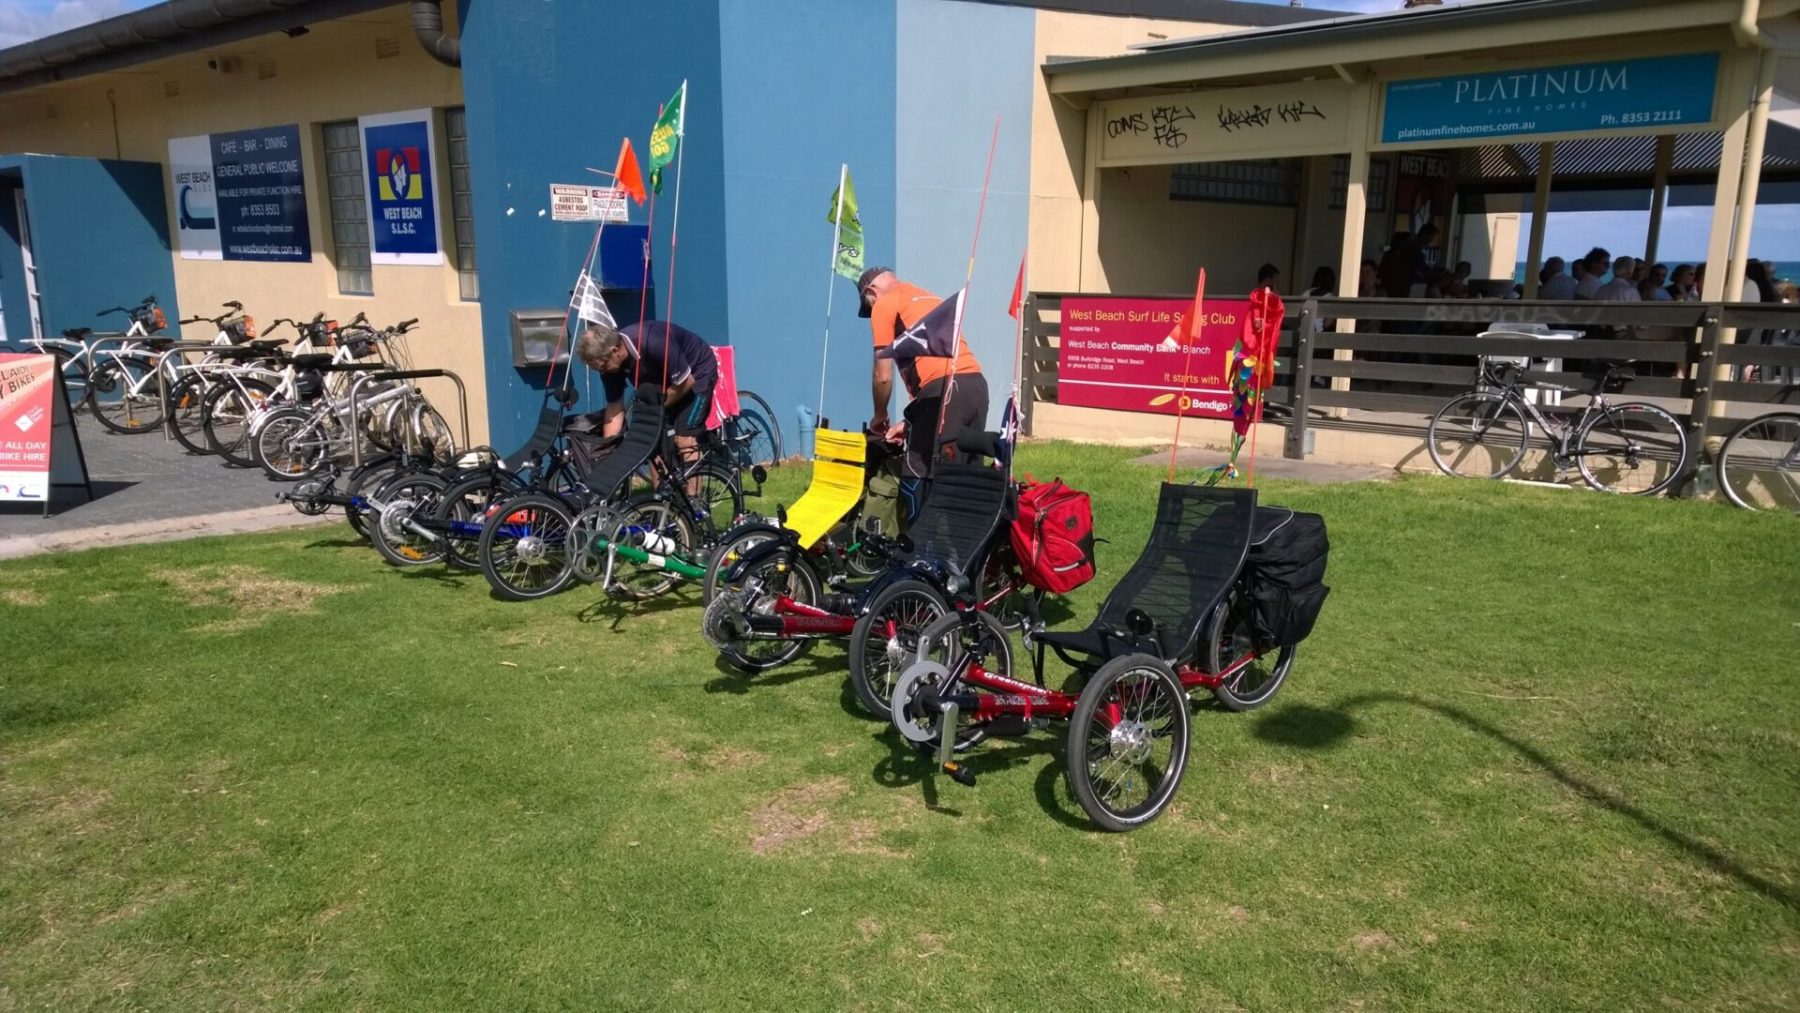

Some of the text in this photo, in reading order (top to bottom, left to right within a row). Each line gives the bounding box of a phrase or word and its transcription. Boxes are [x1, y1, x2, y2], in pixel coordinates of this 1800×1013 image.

[1454, 66, 1629, 103] PLATINUM
[1488, 102, 1587, 114] FINE HOMES
[1601, 110, 1682, 125] Ph. 8353 2111
[1397, 121, 1536, 140] platinumfinehomes.com.au
[244, 139, 257, 152] BAR
[264, 136, 288, 150] DINING
[216, 160, 299, 177] GENERAL PUBLIC WELCOME
[176, 170, 211, 184] WEST BEACH
[383, 206, 423, 220] WEST BEACH
[1069, 309, 1092, 320] West
[1095, 309, 1125, 321] Beach
[1128, 310, 1150, 322] Surf
[1152, 311, 1170, 323] Life
[1211, 313, 1236, 324] Club
[1068, 340, 1085, 348] West
[1087, 340, 1109, 349] Beach
[1111, 341, 1154, 354] Community
[8, 372, 36, 393] BIKES
[1164, 373, 1220, 385] It starts with
[1192, 399, 1228, 412] Bendigo
[5, 441, 47, 450] ALL DAY
[23, 452, 47, 461] HIRE
